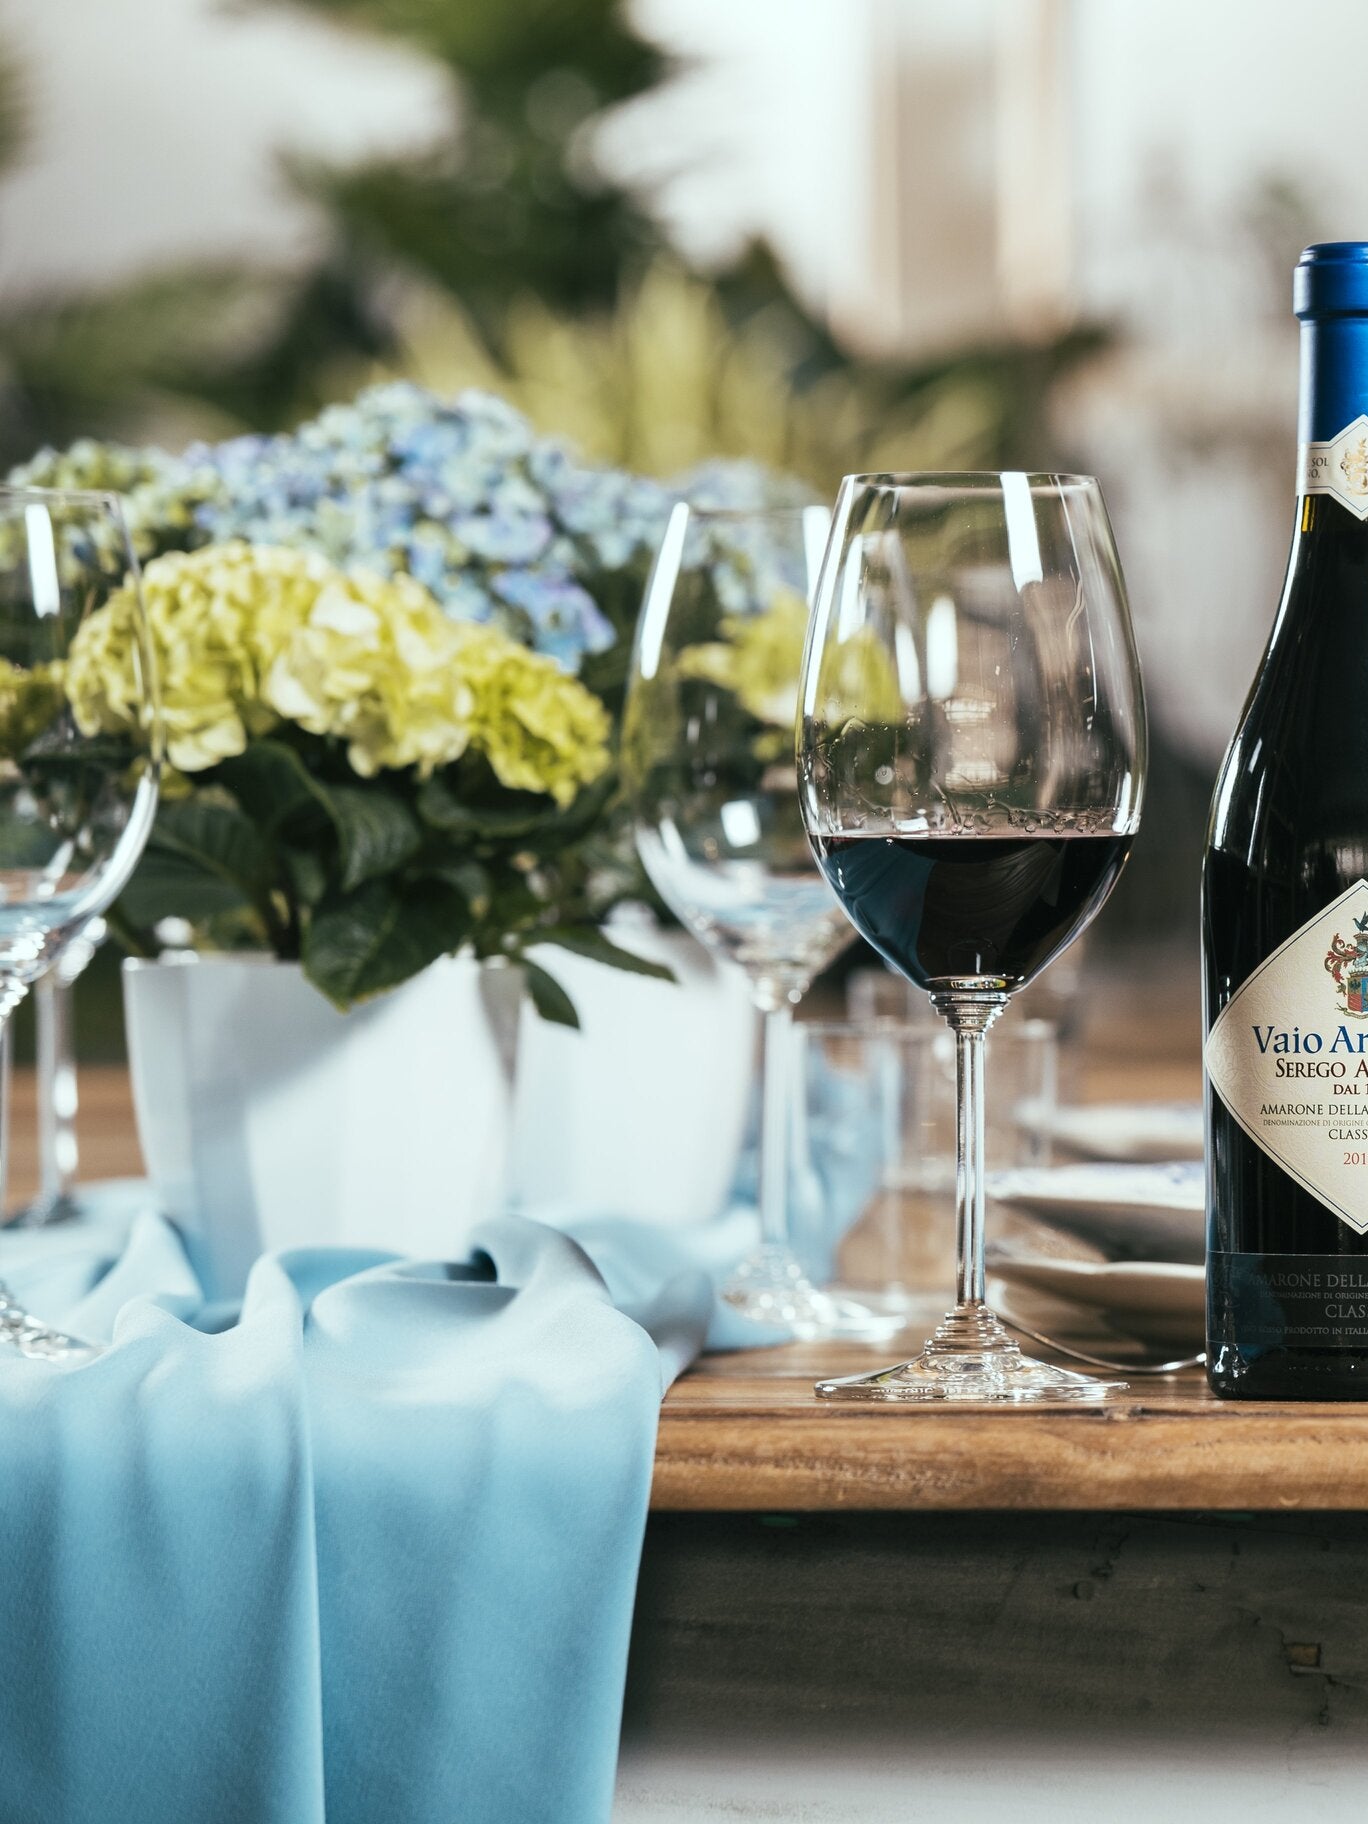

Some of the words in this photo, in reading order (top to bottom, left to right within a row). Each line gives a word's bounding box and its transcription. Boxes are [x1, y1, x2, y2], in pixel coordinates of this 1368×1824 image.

[1252, 1025, 1323, 1054] Vaio
[1275, 1058, 1346, 1078] SEREGO
[1333, 1084, 1360, 1095] DAL
[1260, 1104, 1324, 1115] AMARONE
[1328, 1104, 1368, 1115] DELLA
[1263, 1119, 1321, 1127] DENOMINAZIONE
[1322, 1119, 1331, 1127] DI
[1332, 1119, 1364, 1127] ORIGINE
[1335, 1291, 1368, 1300] ORIGINE
[1332, 1327, 1342, 1335] IN
